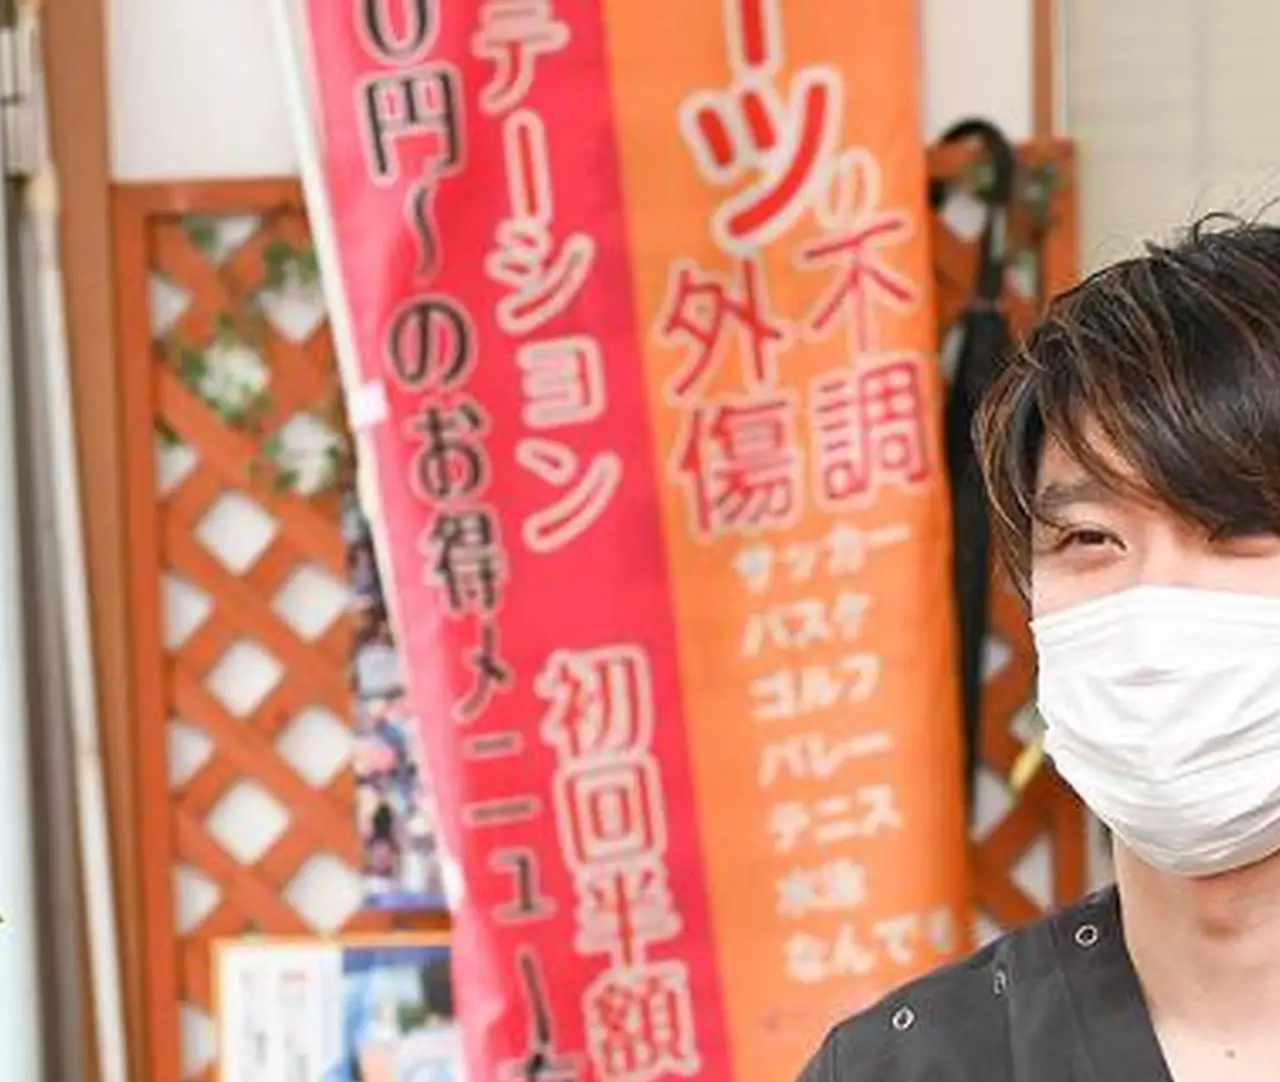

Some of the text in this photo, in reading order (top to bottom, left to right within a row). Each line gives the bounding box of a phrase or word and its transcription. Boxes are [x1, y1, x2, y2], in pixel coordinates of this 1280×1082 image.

[470, 0, 622, 553] テーション
[656, 256, 800, 537] 外傷
[732, 523, 912, 595] サッカー
[741, 592, 872, 658] バスケ
[747, 651, 883, 722] ゴルフ
[756, 731, 891, 786] バレー
[765, 783, 903, 852] テニス
